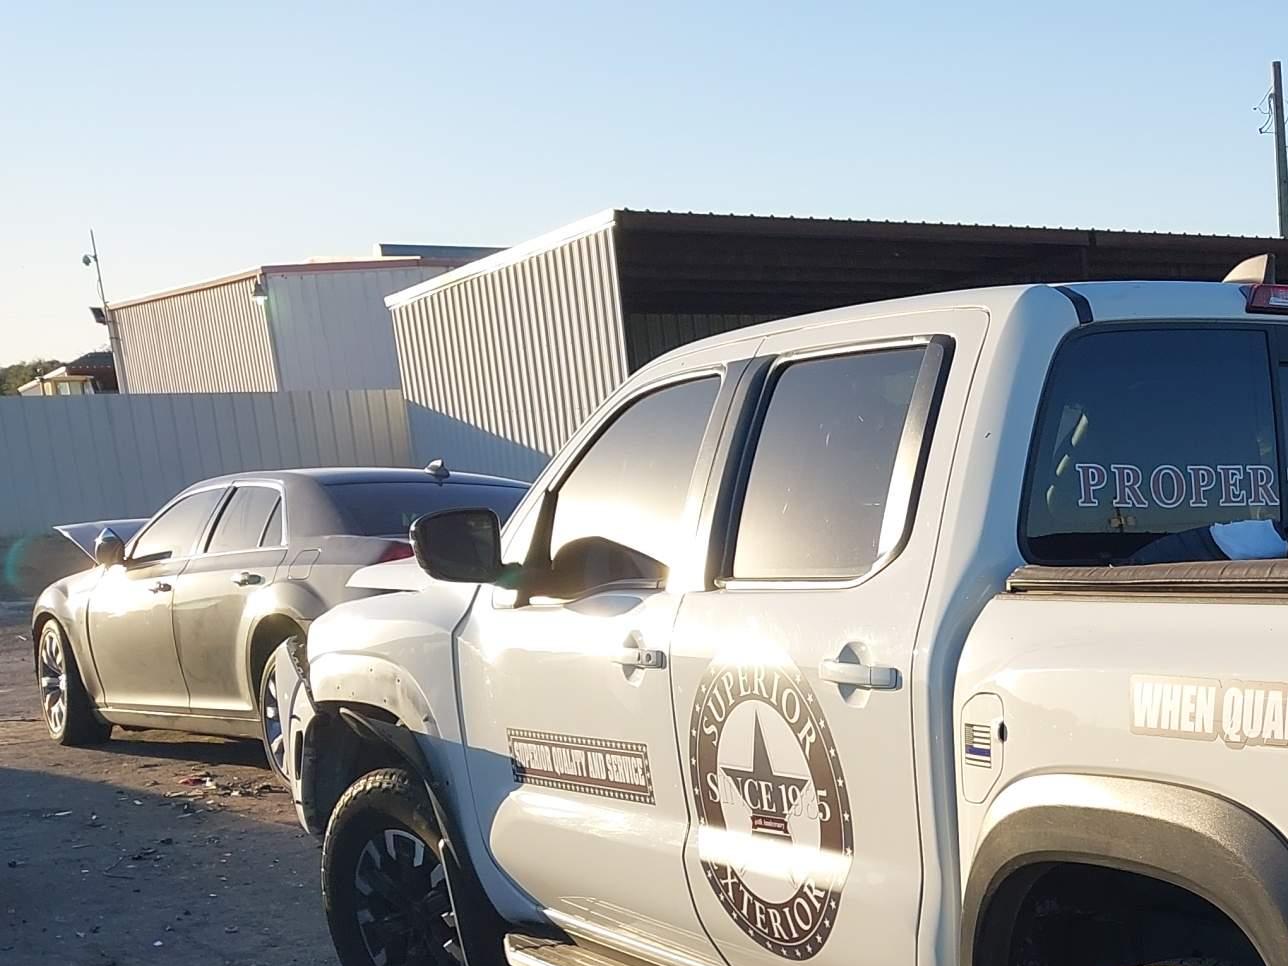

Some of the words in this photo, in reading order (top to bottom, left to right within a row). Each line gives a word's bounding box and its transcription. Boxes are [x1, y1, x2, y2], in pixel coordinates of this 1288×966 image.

[702, 664, 817, 760] SUPERIOR
[1132, 680, 1217, 734] WHEN
[513, 740, 554, 772] SUPERIOR
[551, 746, 588, 777] QUALITY
[586, 750, 607, 780] AND
[605, 753, 645, 786] SERVICE
